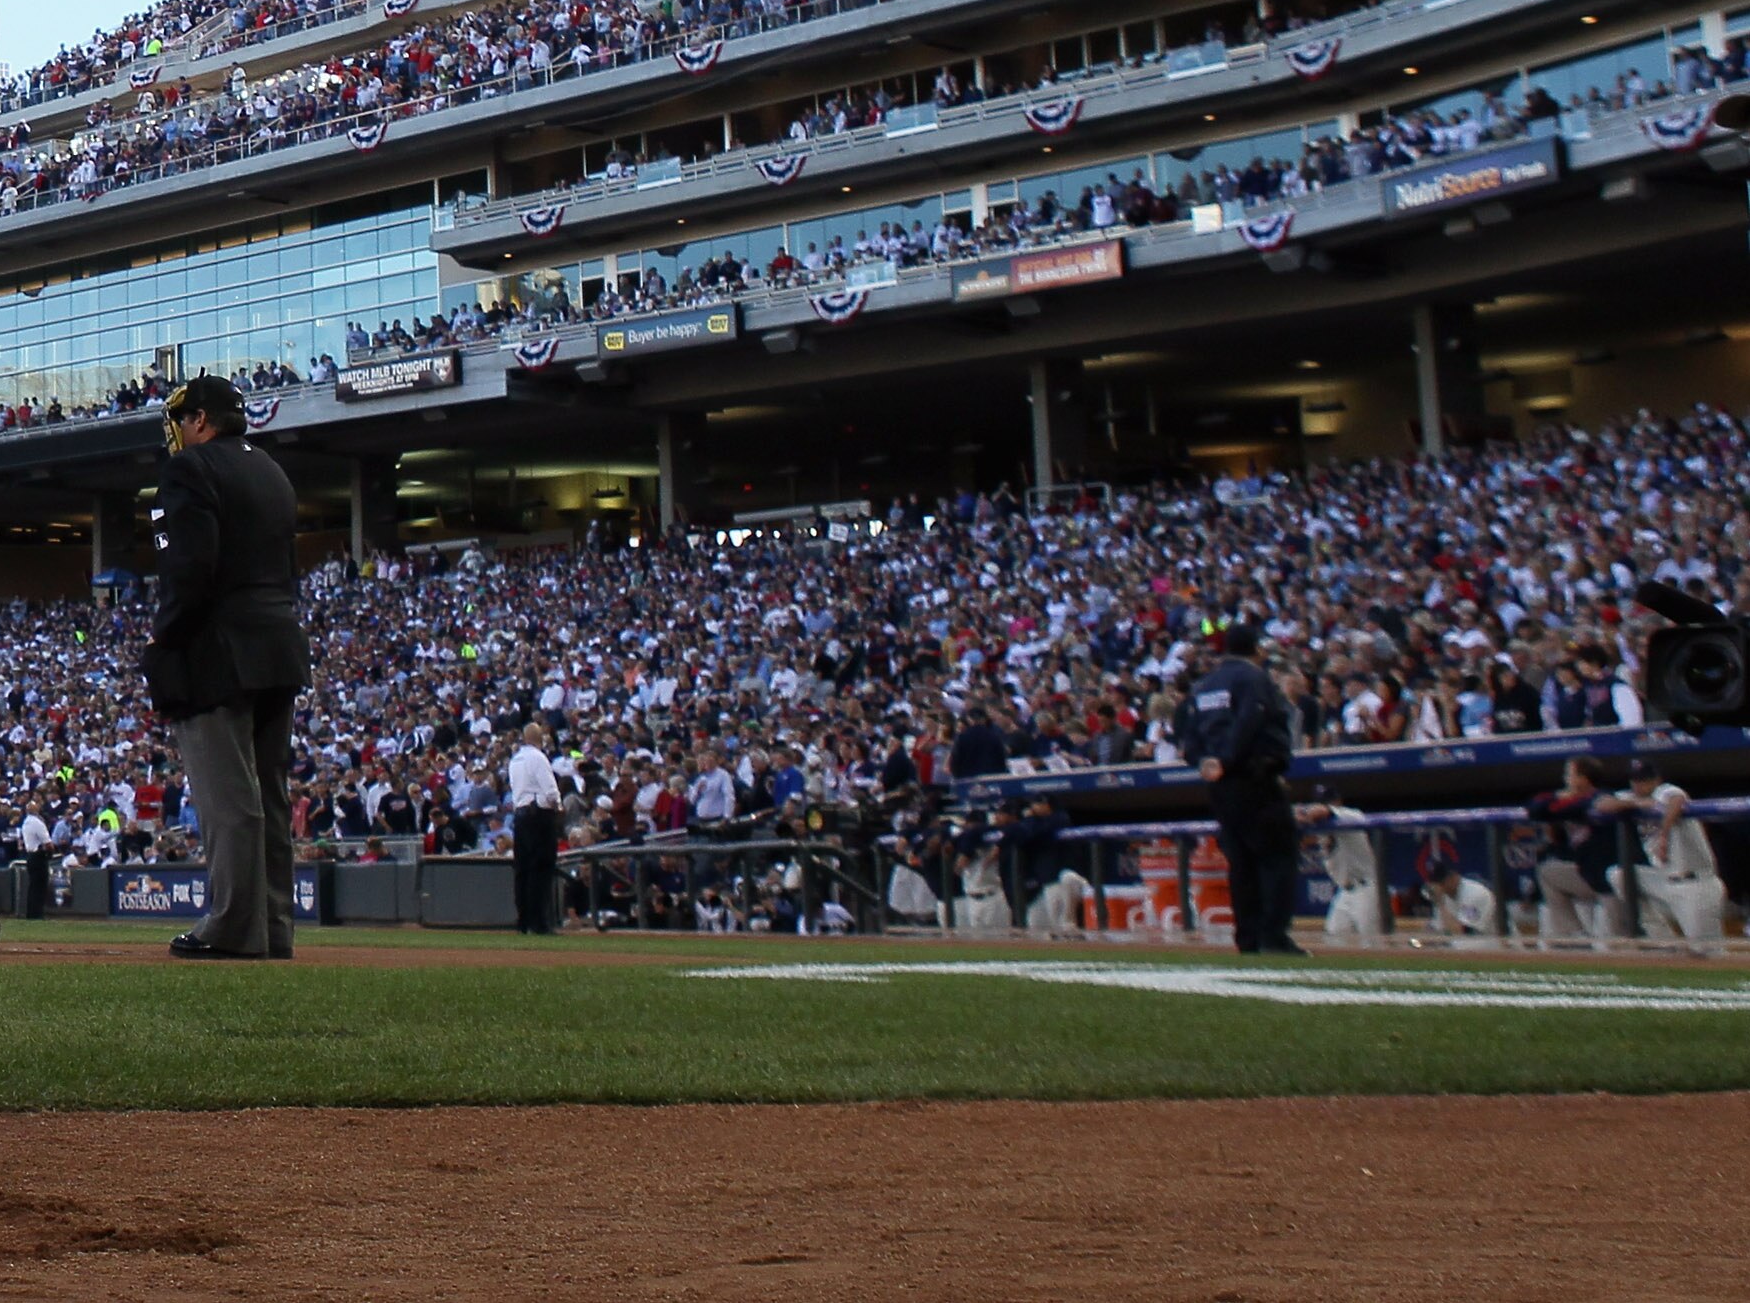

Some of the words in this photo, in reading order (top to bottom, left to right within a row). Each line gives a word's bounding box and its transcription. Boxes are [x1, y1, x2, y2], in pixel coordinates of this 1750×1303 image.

[628, 329, 655, 345] Buyer
[656, 325, 669, 339] be
[338, 368, 370, 384] WATCH
[371, 365, 390, 378] MLB
[391, 358, 432, 376] TONIGHT
[118, 892, 172, 911] POSTSEASON
[173, 883, 191, 903] FOX
